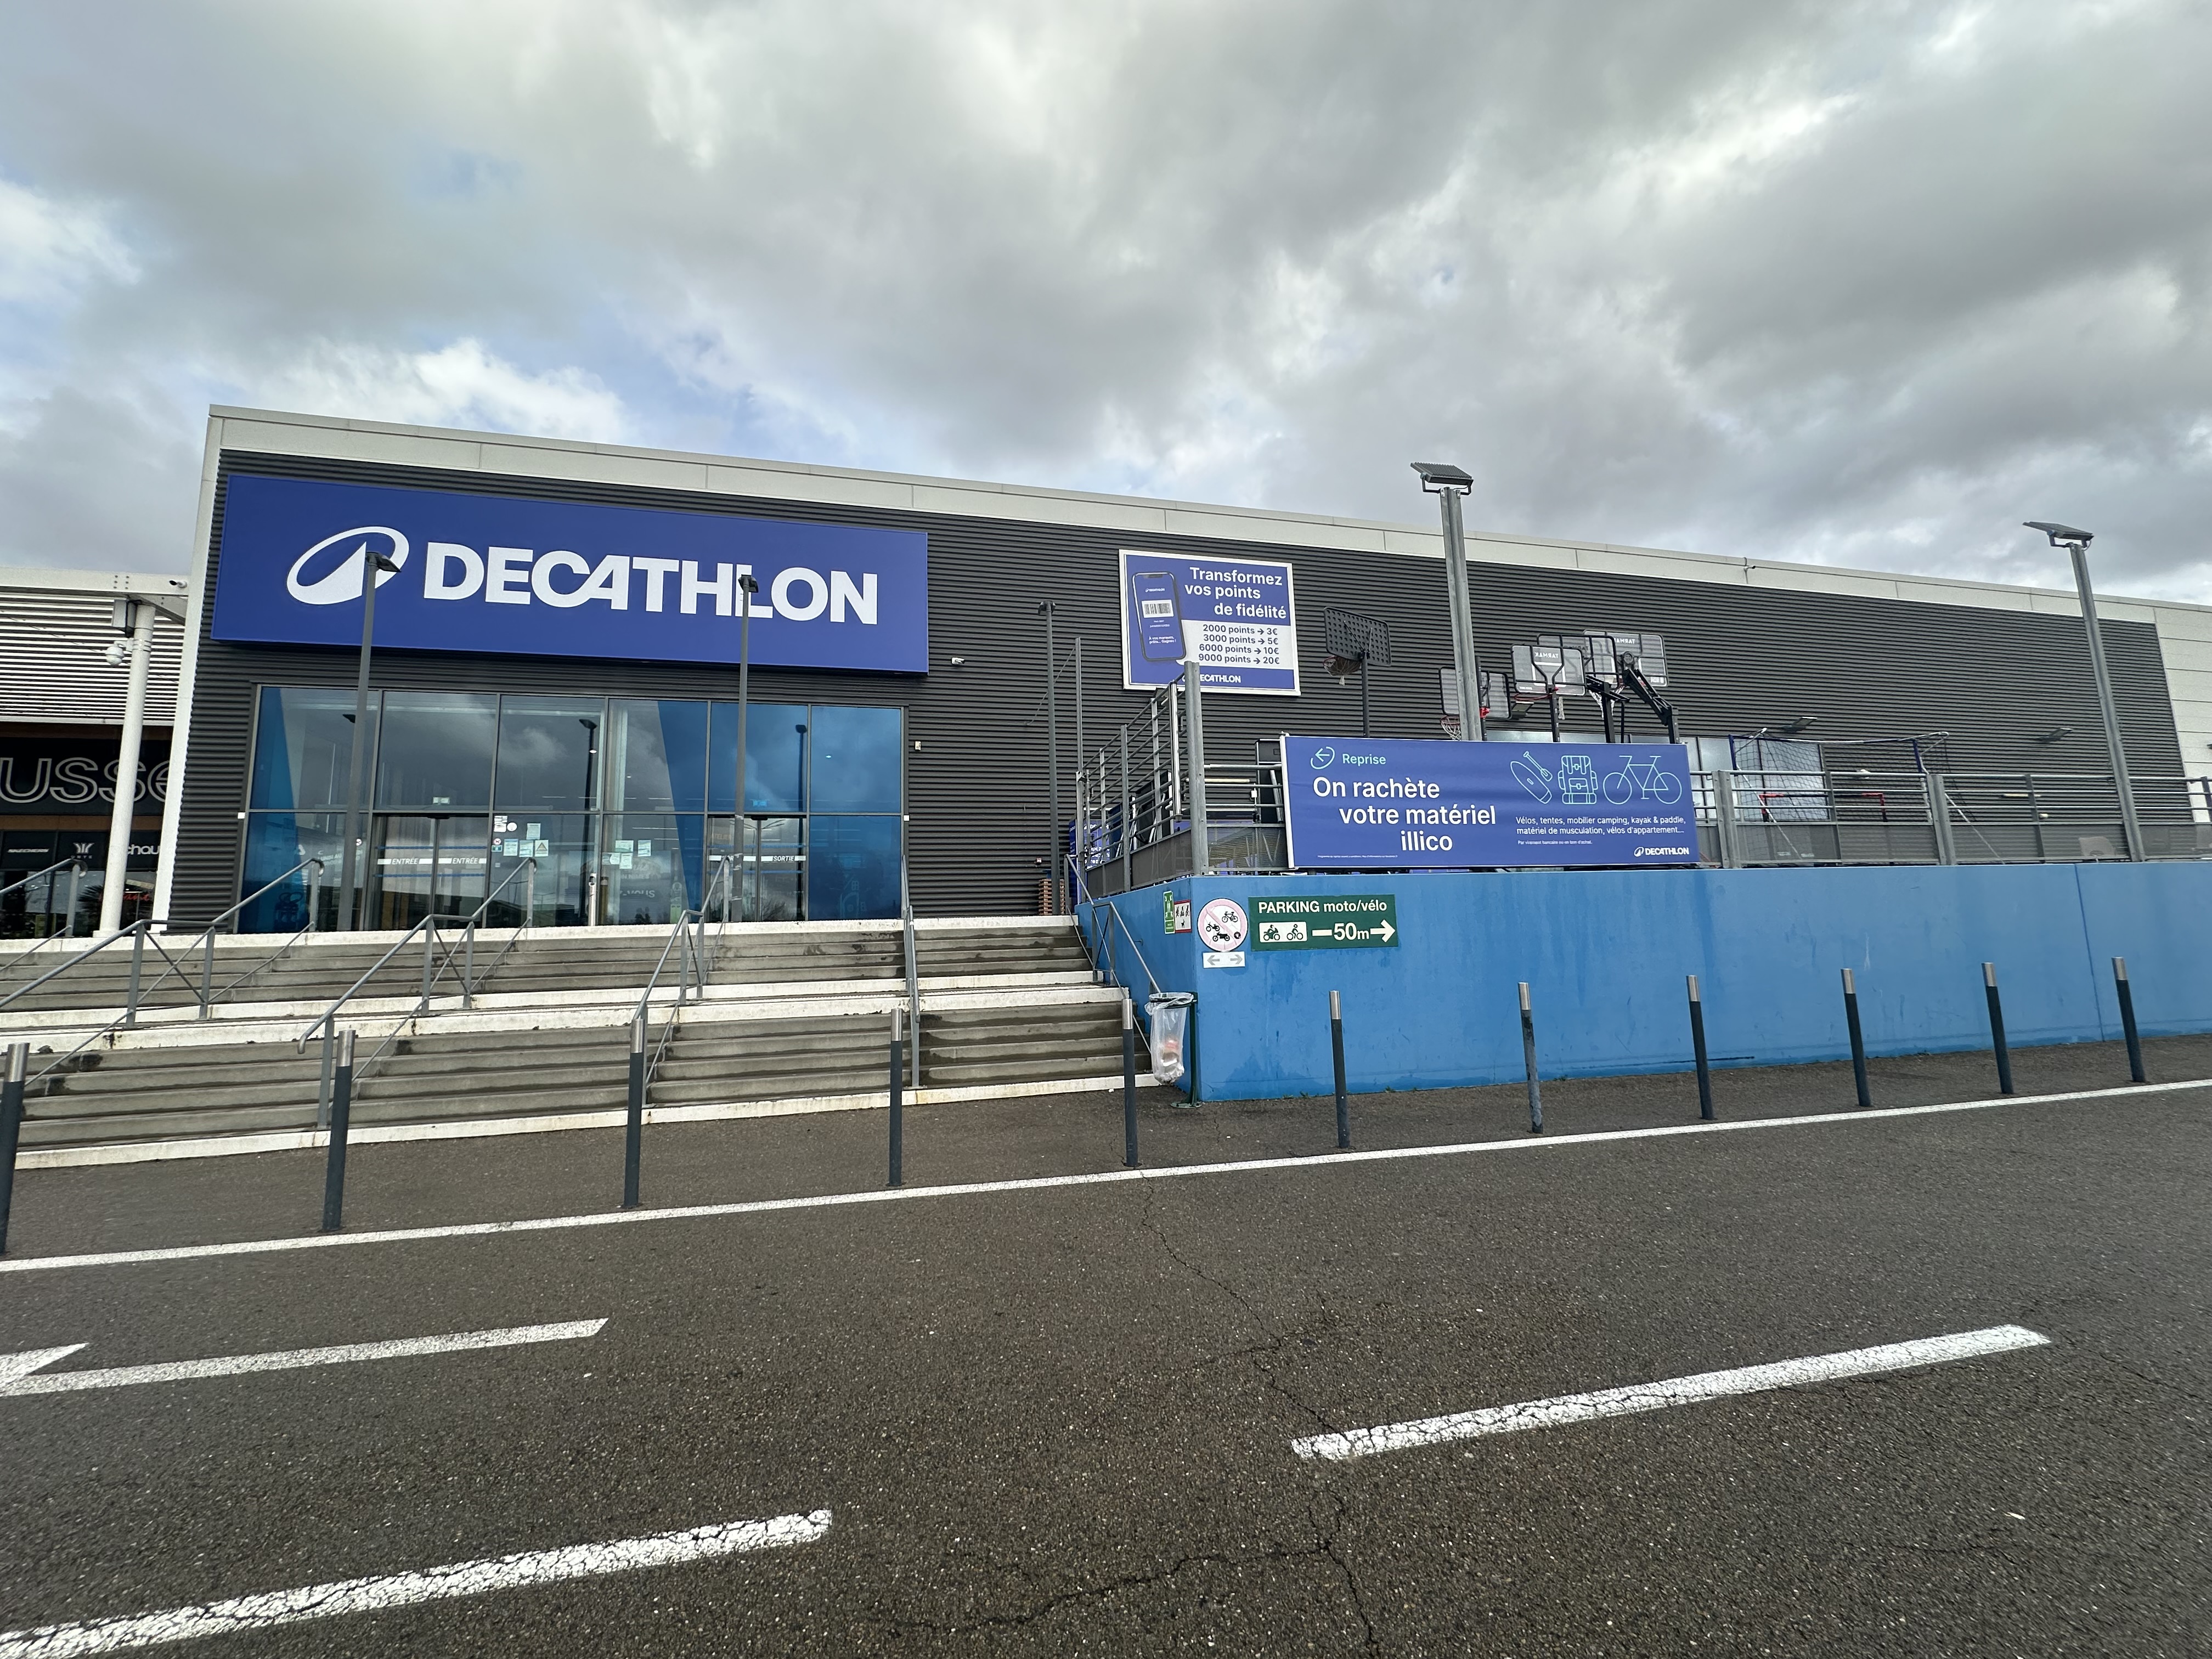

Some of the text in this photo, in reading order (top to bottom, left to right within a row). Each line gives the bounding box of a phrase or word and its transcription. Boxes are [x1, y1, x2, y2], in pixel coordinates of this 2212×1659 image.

[423, 541, 878, 625] DECATHLON
[1189, 567, 1283, 586] Transformez
[1184, 585, 1261, 600] vos points
[1214, 602, 1286, 619] de fidélité
[1203, 624, 1226, 633] 2000
[1228, 625, 1255, 634] points
[1203, 634, 1227, 642] 3000
[1229, 635, 1256, 644] points
[1199, 644, 1223, 652] 6000
[1225, 645, 1252, 653] points
[1198, 653, 1222, 662] 9000
[1224, 654, 1251, 663] points
[1200, 674, 1242, 683] ECATHLON
[1342, 753, 1386, 766] Reprise
[1313, 776, 1440, 798] On rachète
[1339, 804, 1496, 825] votre matériel
[1515, 816, 1538, 825] Vélos,
[1539, 817, 1565, 825] tentes,
[1597, 816, 1629, 826] camping,
[1630, 816, 1651, 825] kayak
[1660, 816, 1686, 825] paddle,
[1516, 826, 1547, 834] matériel
[1560, 826, 1605, 835] musculation,
[1401, 830, 1453, 851] illico
[1645, 847, 1690, 855] DECATHLON
[392, 856, 419, 865] ENTRÉE
[1258, 900, 1387, 913] PARKING moto/vélo
[1333, 922, 1369, 940] 50m
